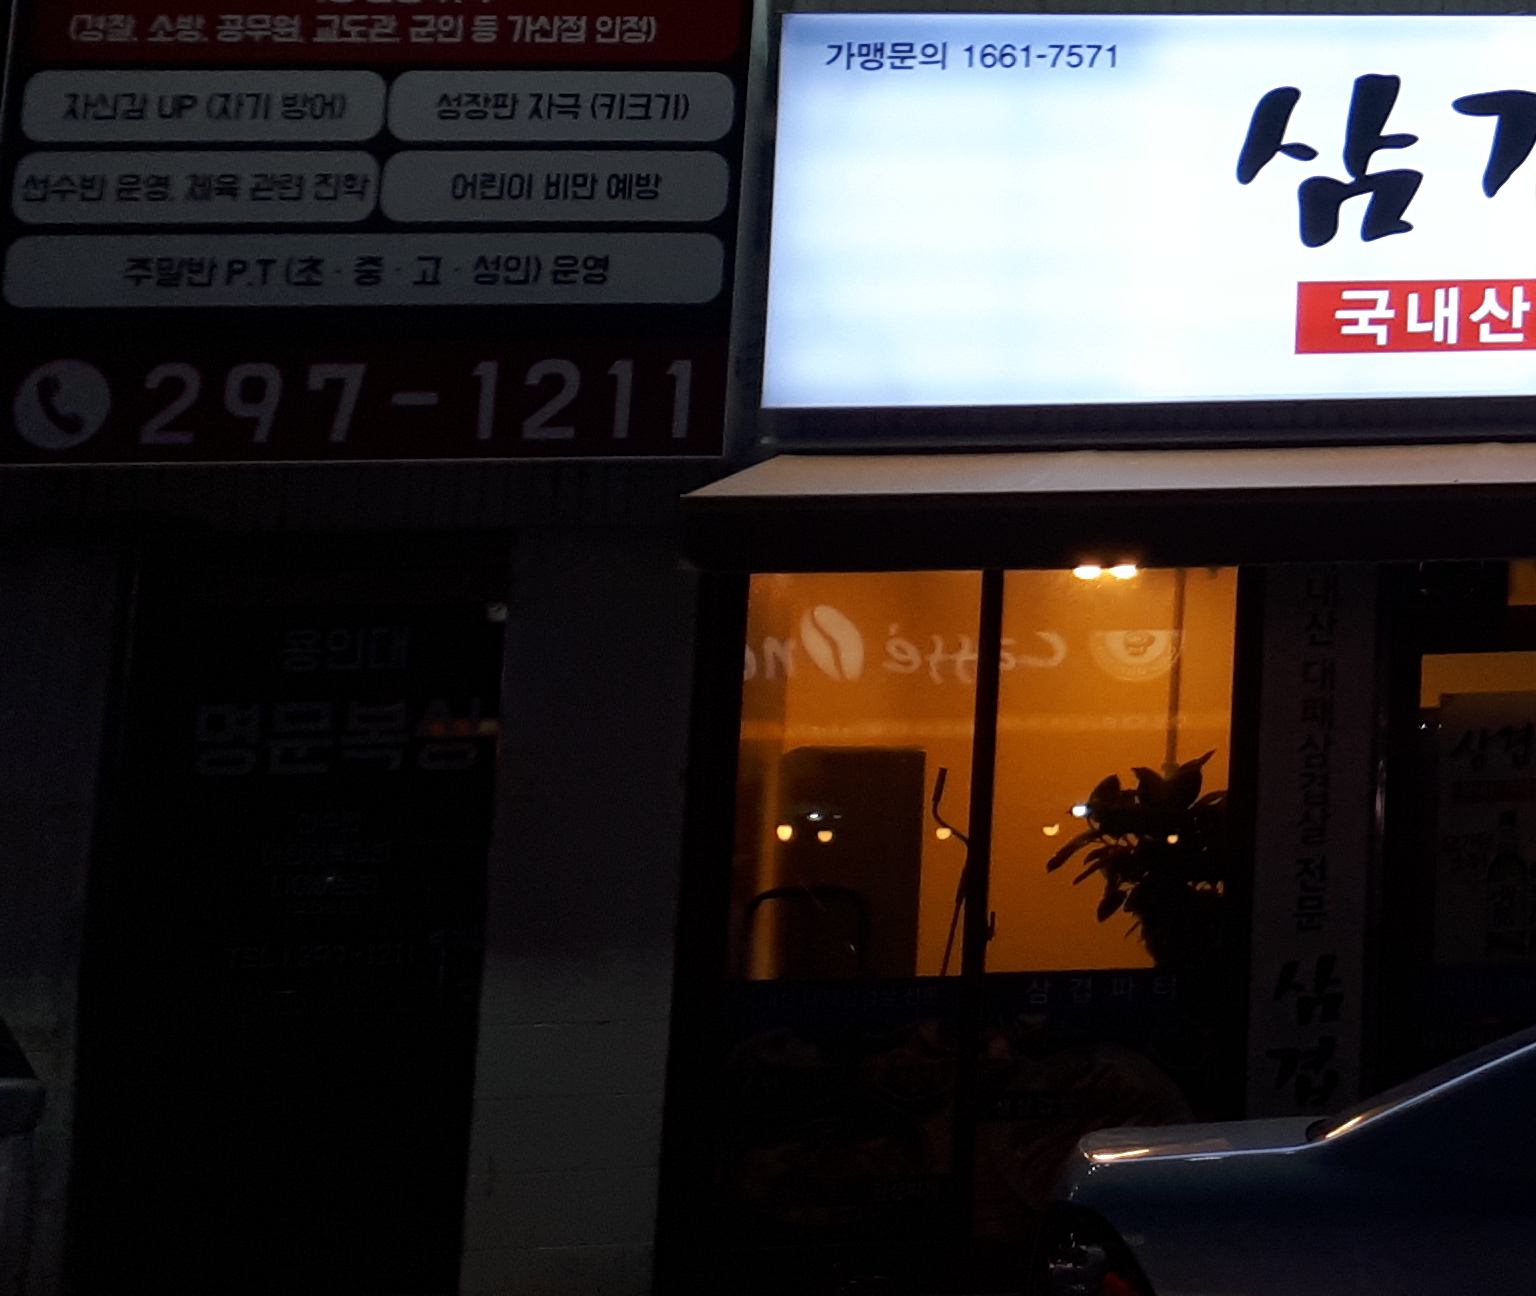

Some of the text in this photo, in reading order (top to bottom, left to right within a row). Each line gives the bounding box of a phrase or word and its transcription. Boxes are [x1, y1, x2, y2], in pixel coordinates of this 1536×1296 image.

[408, 14, 464, 44] 군인
[470, 14, 499, 44] 등
[506, 14, 588, 44] 가산점
[594, 15, 660, 44] 인정)
[825, 41, 1119, 72] 가맹문의 1661-7571
[61, 92, 147, 120] 자신감
[157, 94, 198, 120] UP
[436, 91, 691, 122] 성장판 자극 (키크기)
[23, 173, 104, 202] 선수반
[186, 173, 240, 202] 체육
[250, 173, 304, 202] 관련
[313, 173, 370, 202] 진학
[451, 172, 663, 201] 어린이 비만 예방
[124, 256, 217, 288] 주말반
[225, 258, 278, 287] P.T
[552, 254, 610, 286] 운영
[1335, 287, 1531, 347] 국내산
[138, 356, 694, 446] 297-1211
